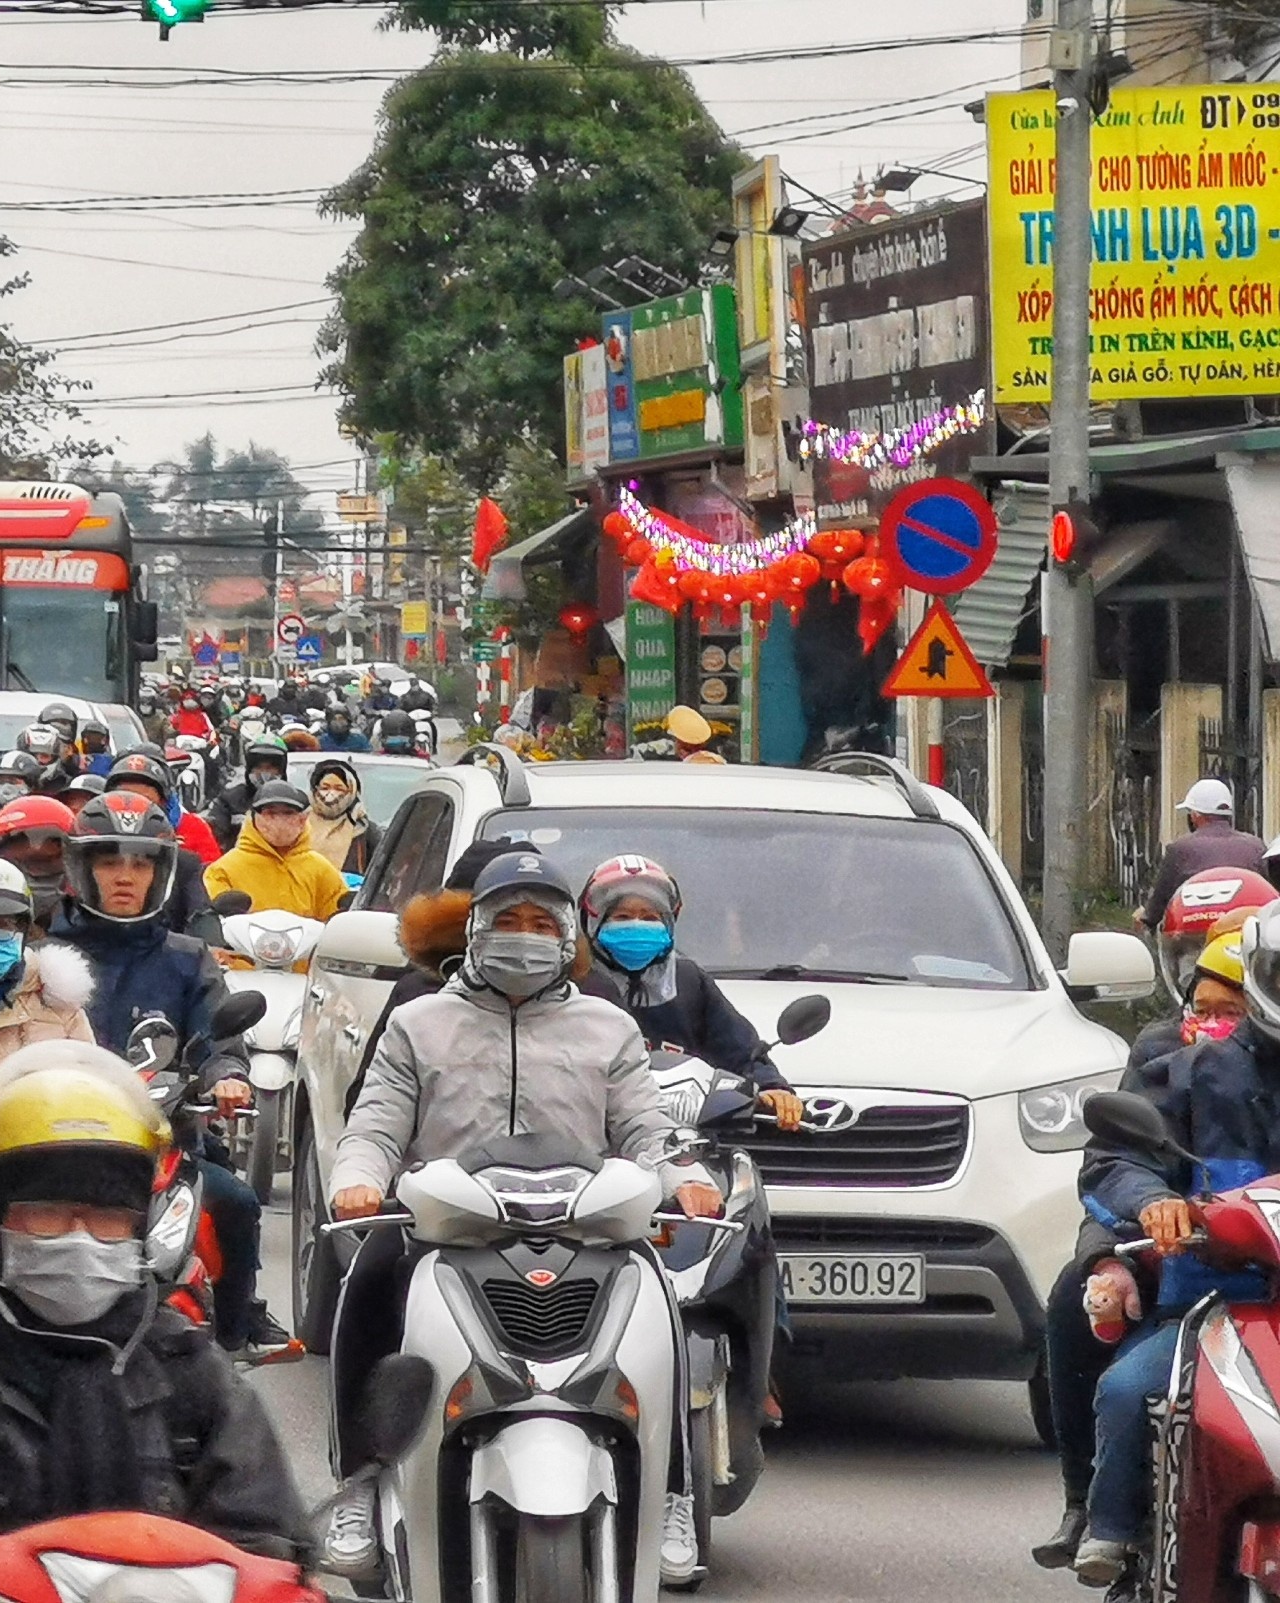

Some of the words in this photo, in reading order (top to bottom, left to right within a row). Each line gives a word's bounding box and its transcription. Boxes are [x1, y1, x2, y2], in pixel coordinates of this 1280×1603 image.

[1200, 95, 1231, 128] ĐT
[1010, 143, 1043, 195] GIẢI
[1099, 156, 1131, 192] CHO
[1136, 144, 1192, 191] TƯỜNG
[1229, 137, 1267, 188] MỐC
[1019, 207, 1130, 266] TRNH
[1141, 205, 1205, 274] LỤA
[1215, 204, 1257, 260] 3D
[1017, 278, 1053, 323] XỐP
[1229, 275, 1271, 318] CÁCH
[1100, 334, 1120, 352] IN
[1126, 327, 1176, 352] TRÊN
[1239, 328, 1280, 353] GẠC
